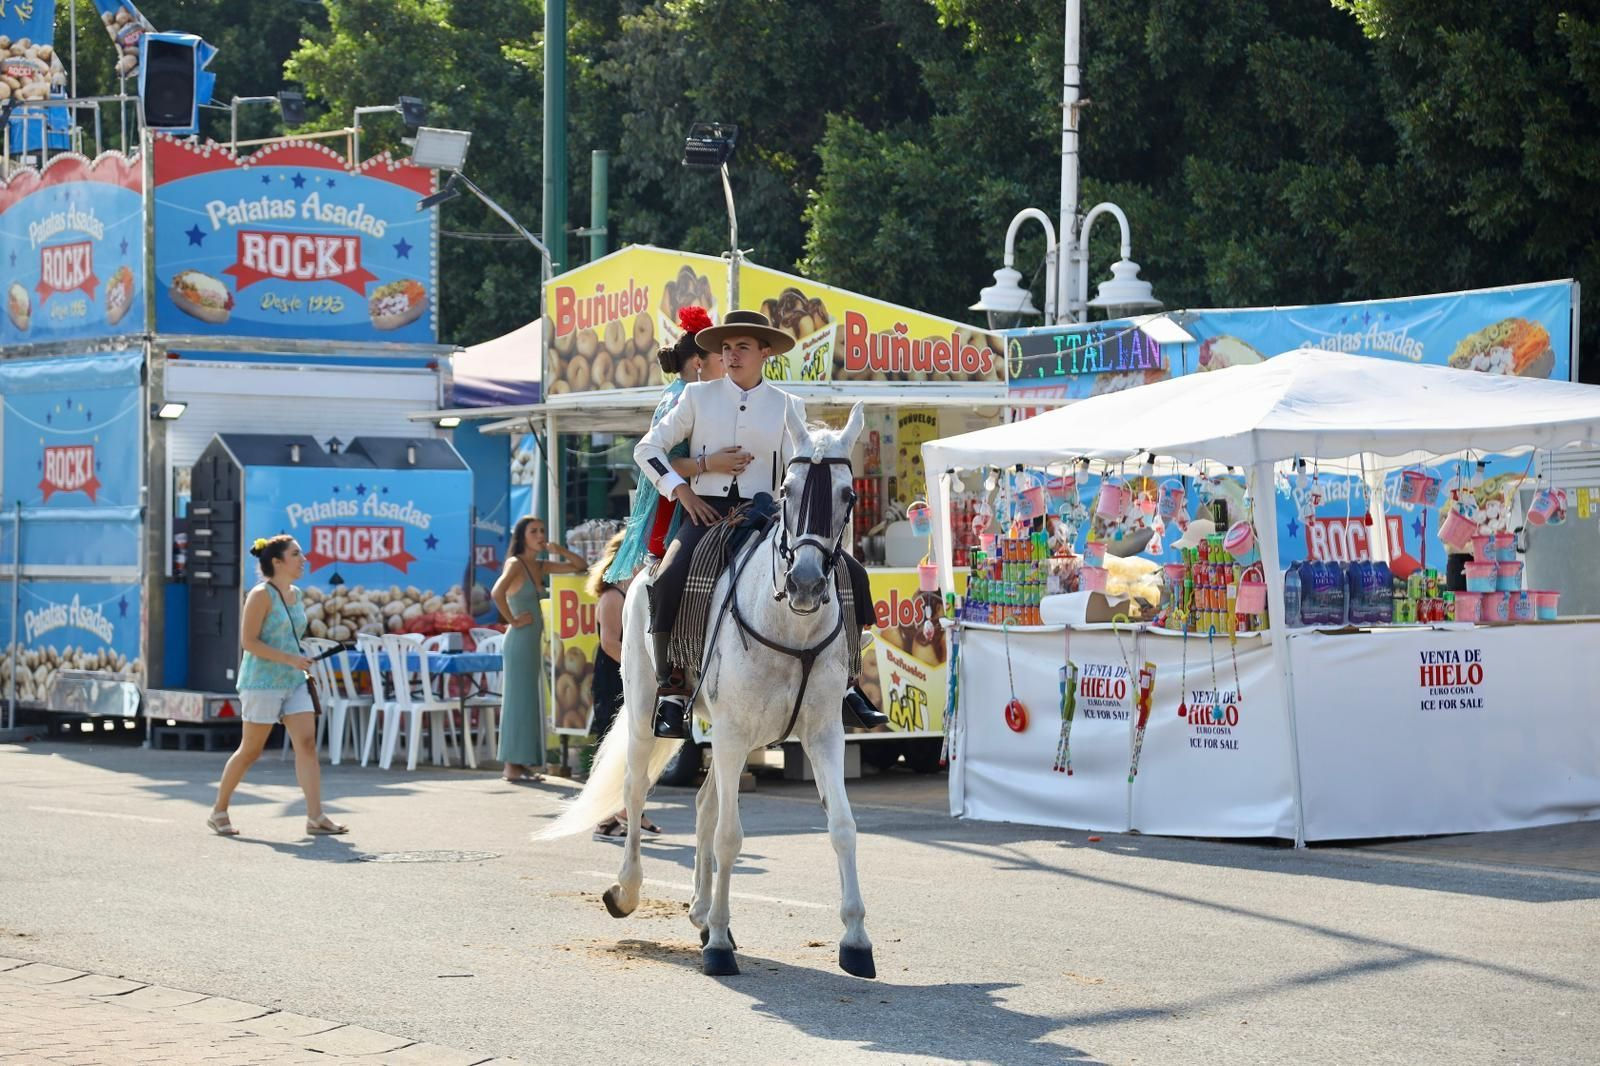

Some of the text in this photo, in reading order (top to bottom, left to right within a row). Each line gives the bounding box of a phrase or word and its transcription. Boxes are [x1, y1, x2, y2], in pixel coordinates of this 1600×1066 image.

[29, 201, 105, 251] Patatas Asadas
[206, 191, 388, 239] Patatas Asadas
[43, 243, 92, 290] ROCKI
[242, 233, 357, 279] ROCKI
[555, 278, 649, 338] Buñuelos
[845, 310, 993, 374] Buñuelos
[1366, 321, 1424, 362] Asadas
[46, 447, 94, 490] ROCKI
[286, 492, 432, 530] Patatas Asadas
[315, 528, 401, 562] ROCKI
[1310, 519, 1402, 561] ROCI
[24, 593, 115, 645] Patatas Asadas
[872, 588, 925, 630] elos
[1084, 664, 1113, 678] VENTA
[1420, 648, 1482, 664] VENTA DE
[1420, 663, 1483, 687] HIELO
[1080, 677, 1126, 700] HIELO
[1222, 691, 1237, 704] DE
[1421, 698, 1484, 711] ICE FOR SALE
[1429, 686, 1474, 696] EURO COSTA
[1190, 738, 1239, 750] ICE FOR SALE
